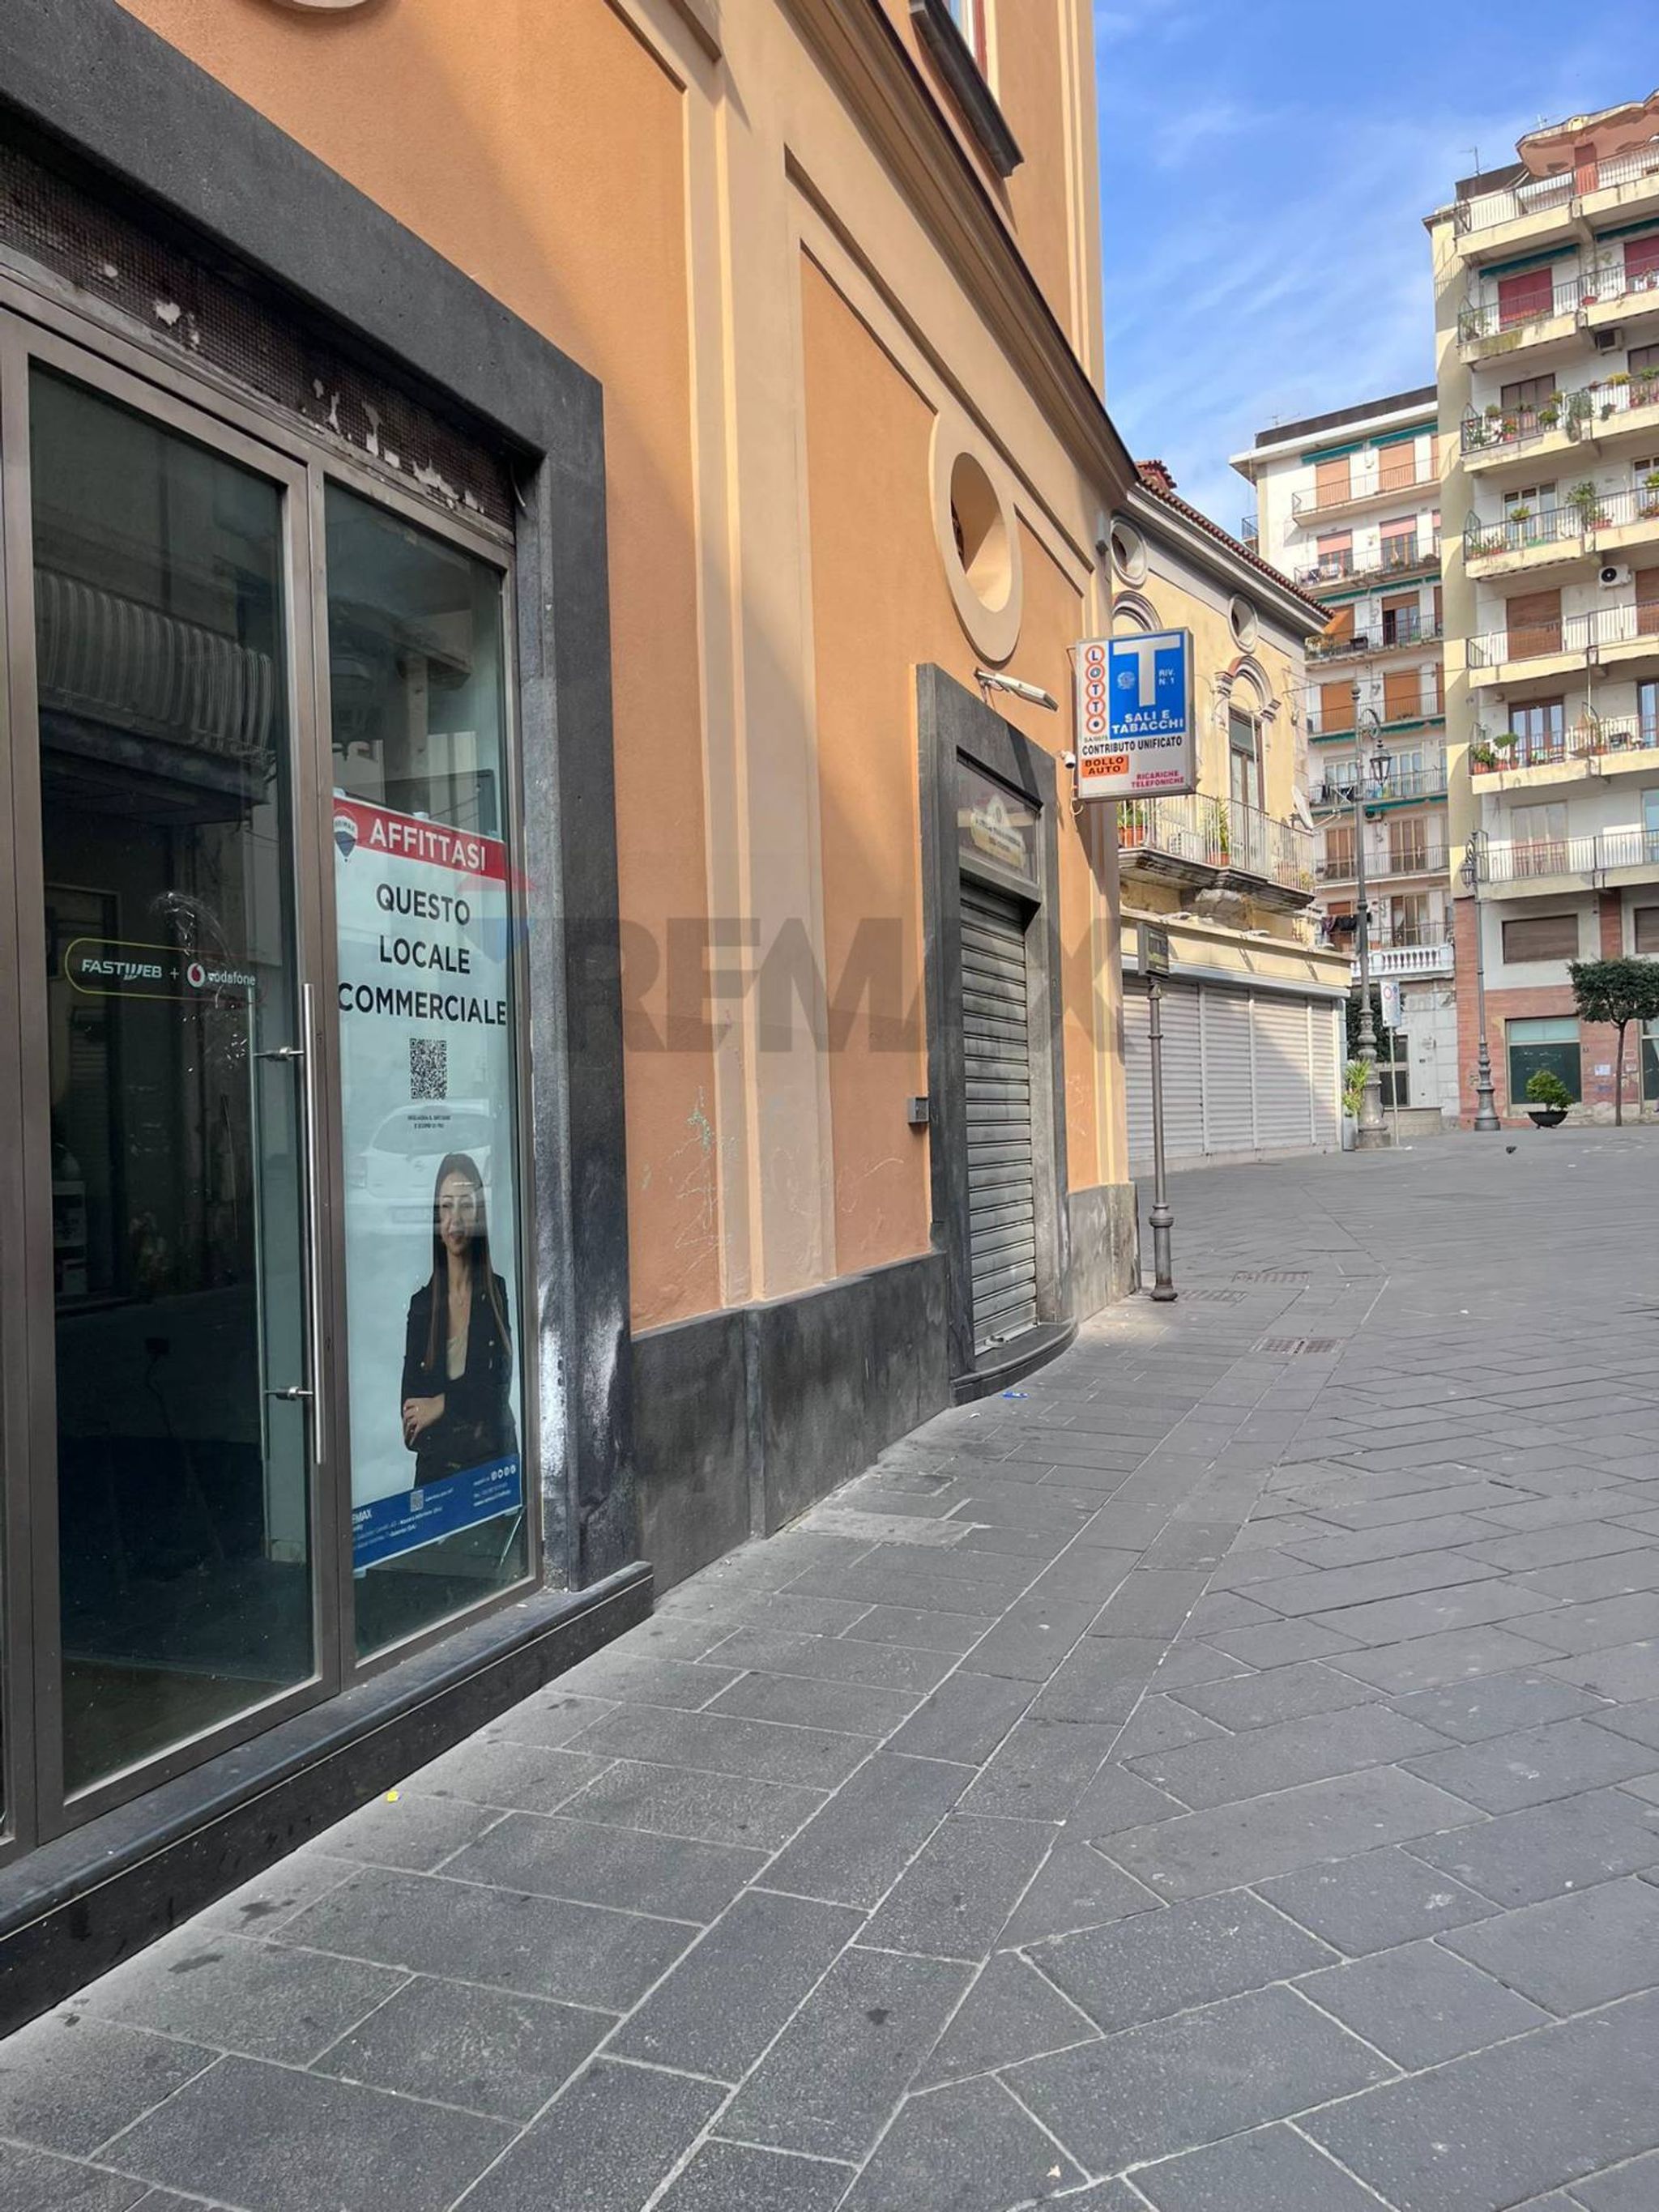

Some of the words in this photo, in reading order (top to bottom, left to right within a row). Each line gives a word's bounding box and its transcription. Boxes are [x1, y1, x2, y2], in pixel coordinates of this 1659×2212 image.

[1113, 634, 1180, 707] T
[1111, 718, 1183, 735] TABACCHI
[1124, 710, 1157, 723] SALI
[1162, 710, 1170, 719] E
[1082, 741, 1135, 756] CONTRIBUTO
[1137, 736, 1183, 750] UNIFICATO
[1085, 757, 1124, 767] BOLLO
[1089, 765, 1121, 775] AUTO
[1131, 777, 1184, 788] TELEFONICHE
[1137, 769, 1179, 780] RICARICHE
[369, 818, 486, 872] AFFITTASI
[377, 884, 471, 925] QUESTO
[379, 935, 471, 974] LOCALE
[82, 959, 162, 980] FASTWEB
[207, 970, 256, 986] vodafone
[338, 982, 506, 1025] COMMERCIALE
